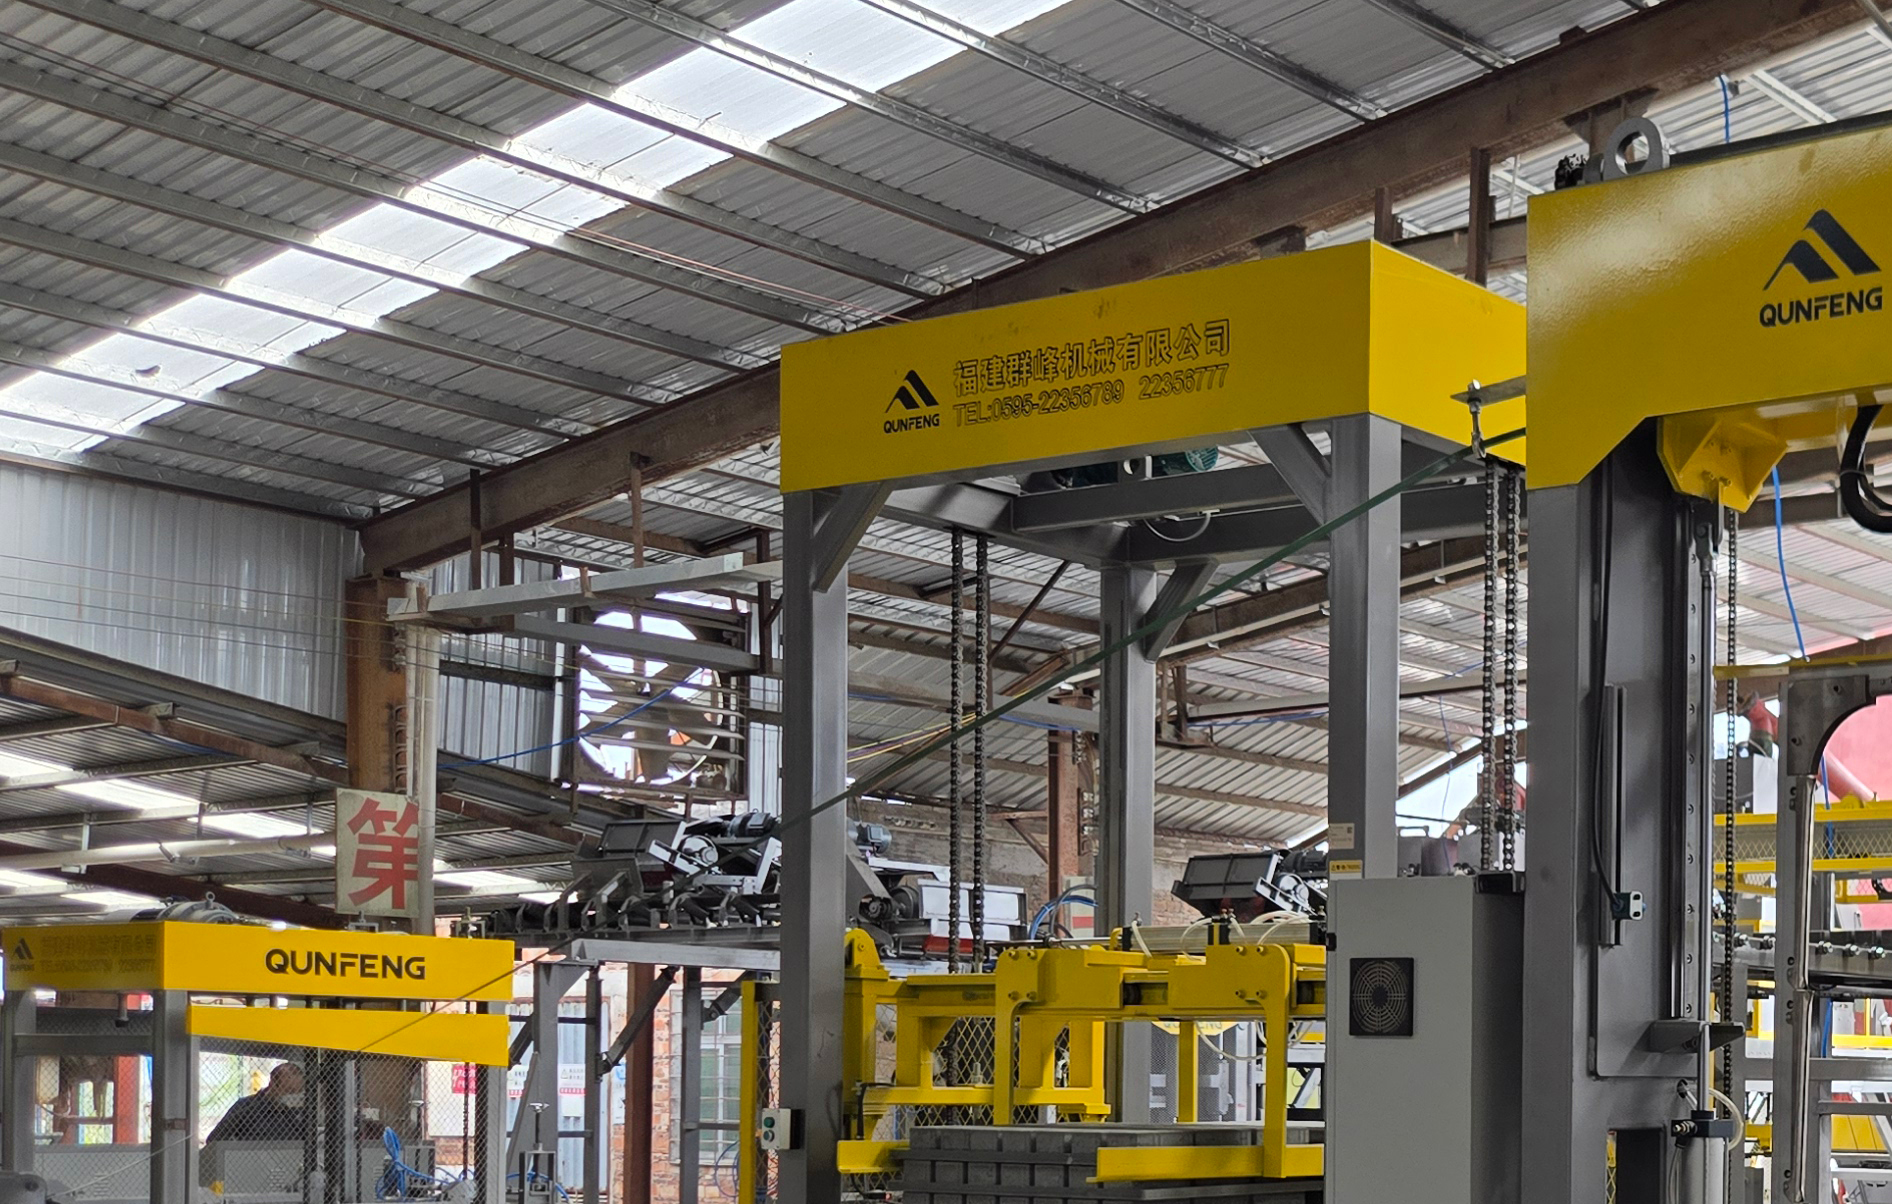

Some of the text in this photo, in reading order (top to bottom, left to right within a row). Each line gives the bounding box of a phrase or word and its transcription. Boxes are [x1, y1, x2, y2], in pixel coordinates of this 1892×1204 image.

[1759, 286, 1883, 328] QUNFENG
[953, 318, 1230, 398] 福建群峰机械有限公司
[952, 363, 1230, 427] TEL:0595-22356789 22356777
[883, 413, 940, 435] QUNFENG
[346, 796, 419, 911] 第
[265, 947, 426, 980] QUNFENG
